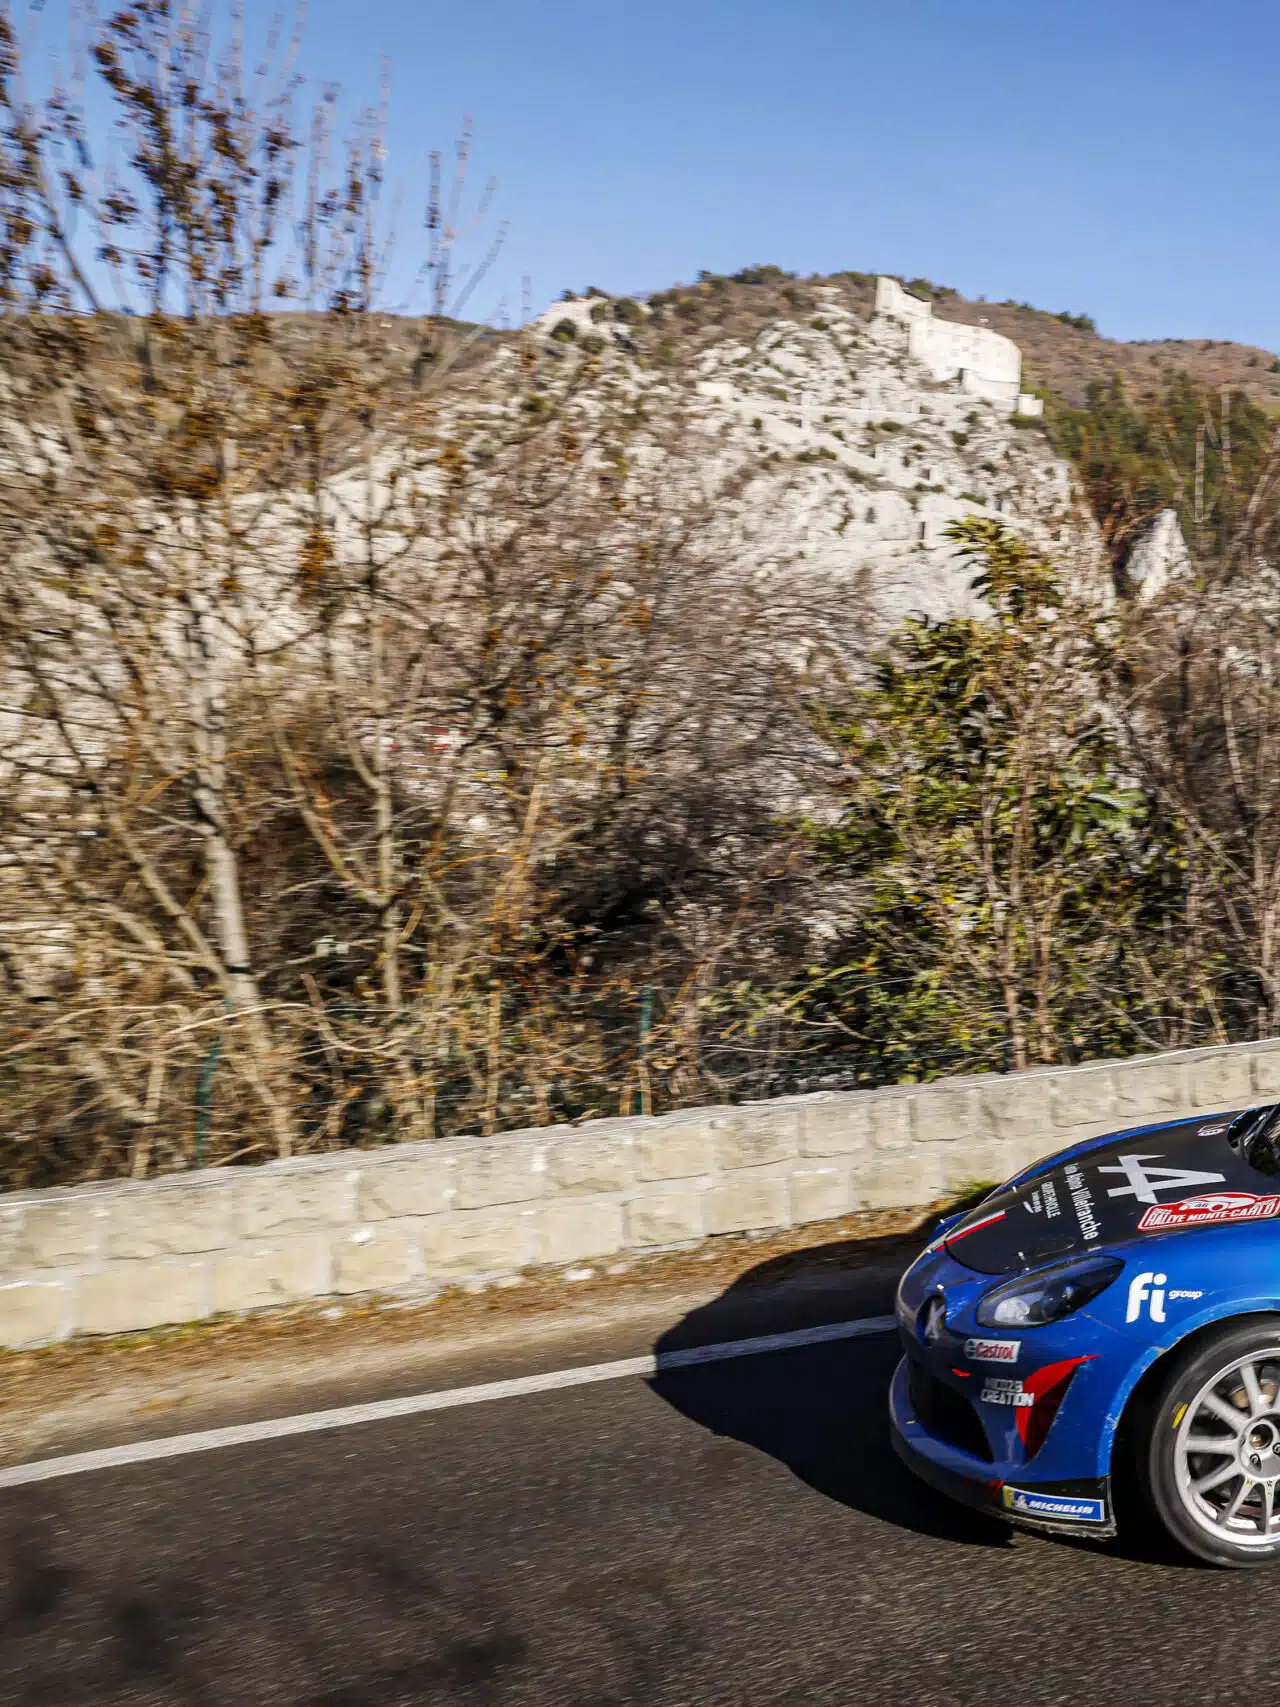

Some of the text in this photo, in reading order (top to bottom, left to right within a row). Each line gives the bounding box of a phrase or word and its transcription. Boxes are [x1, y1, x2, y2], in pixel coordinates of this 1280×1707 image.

[1145, 1211, 1185, 1227] RALLYE
[1125, 1272, 1203, 1323] fi group
[975, 1341, 1015, 1360] Castrol
[1028, 1500, 1095, 1514] MICHELIN
